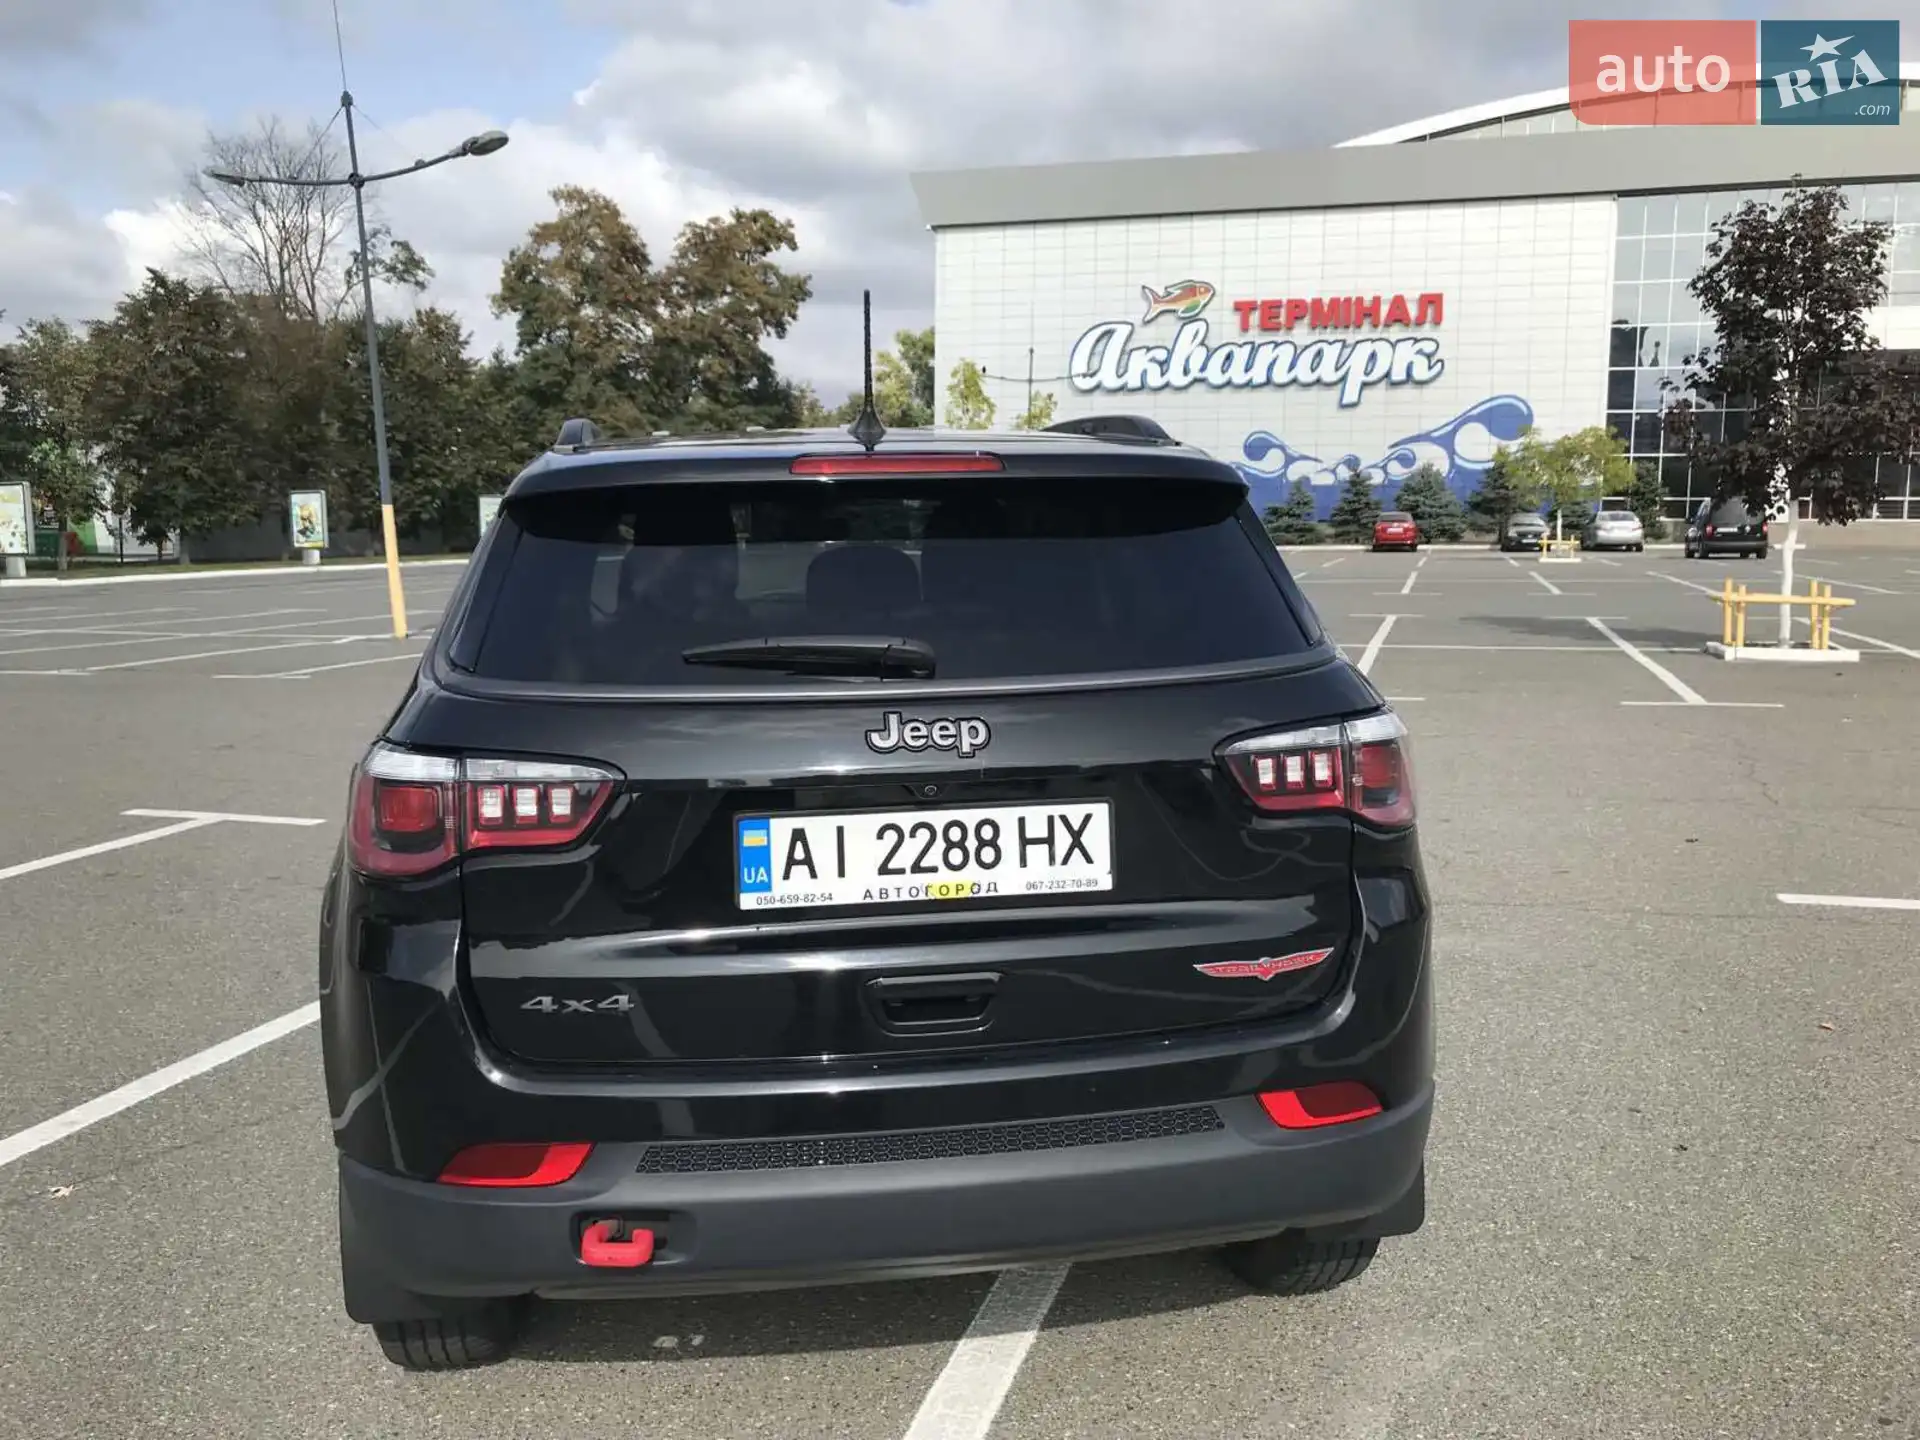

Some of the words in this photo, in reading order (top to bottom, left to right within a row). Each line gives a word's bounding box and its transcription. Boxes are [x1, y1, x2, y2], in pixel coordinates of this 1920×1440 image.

[1233, 293, 1444, 332] ТЕРМІНАЛ
[1070, 318, 1445, 408] Аквапарк
[866, 711, 991, 757] Jeep
[876, 818, 1002, 877] 2288
[743, 867, 769, 885] UA
[1025, 879, 1099, 893] 067-232-70-89
[755, 892, 833, 906] 050-659-82-54
[862, 881, 999, 903] АВТОГОРОД
[520, 993, 636, 1014] 4x4
